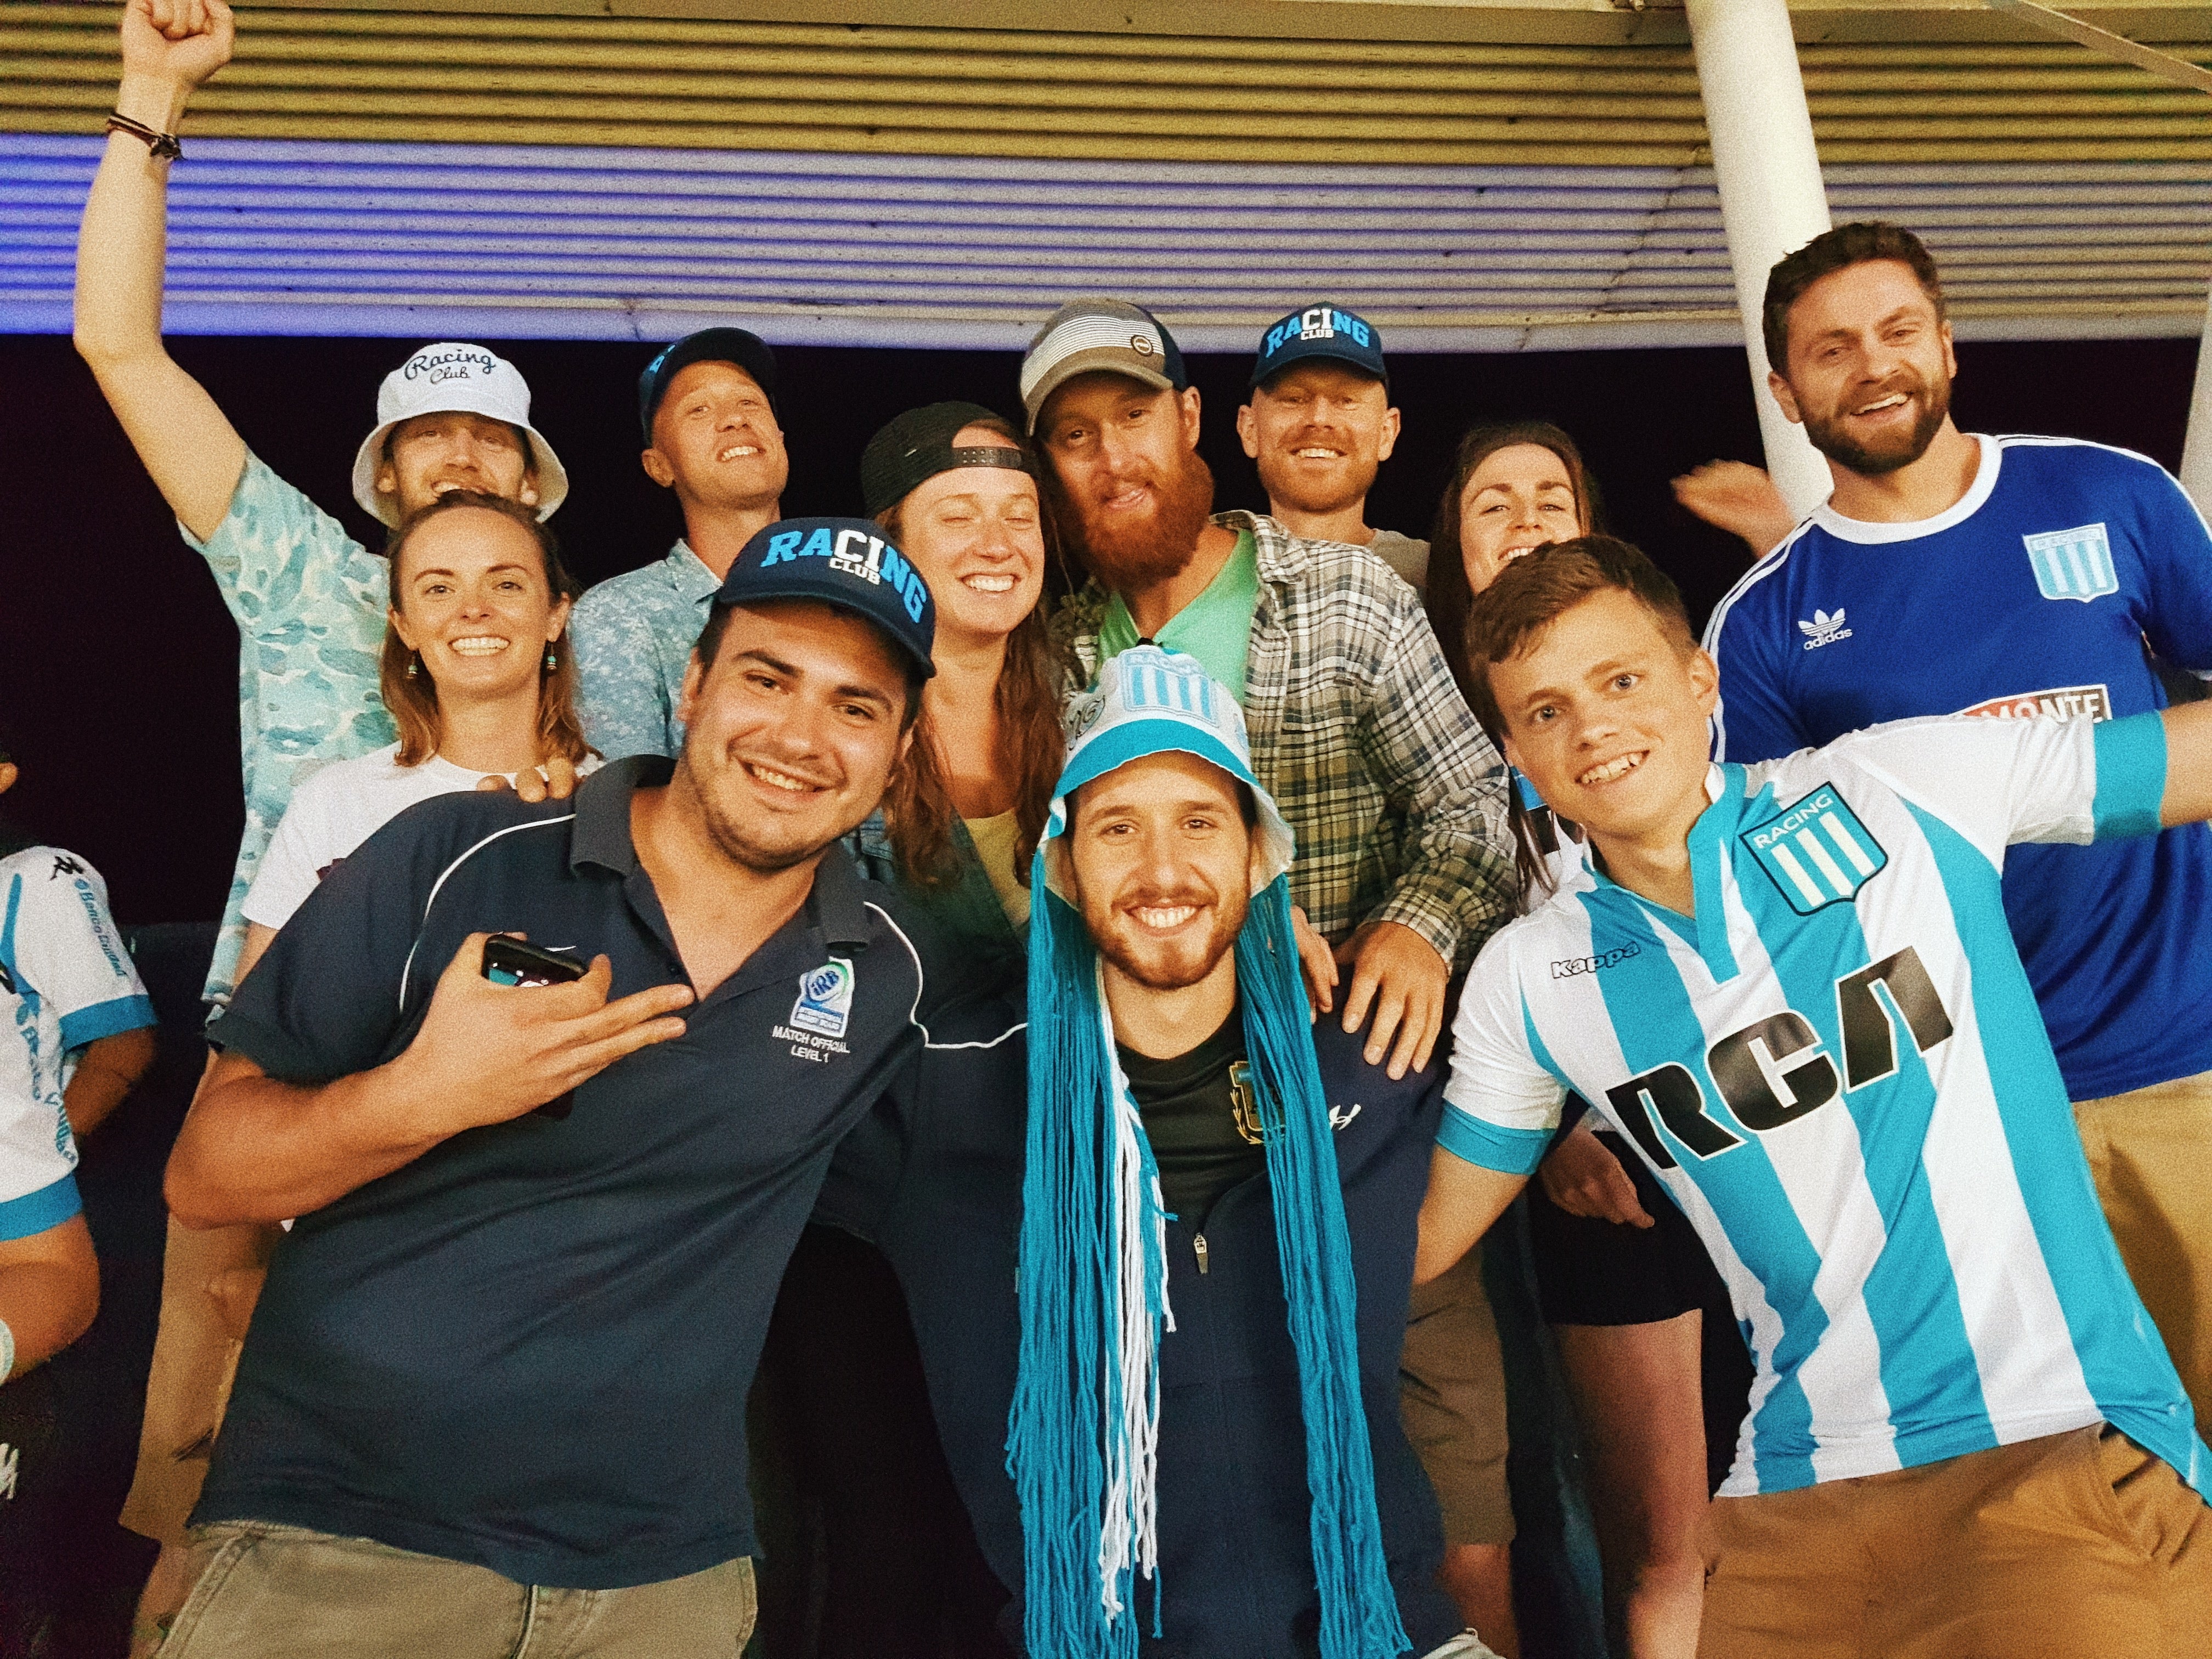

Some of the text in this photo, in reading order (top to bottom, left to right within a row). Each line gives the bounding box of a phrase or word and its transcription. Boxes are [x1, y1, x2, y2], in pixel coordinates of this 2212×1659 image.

[1266, 308, 1369, 358] RACING
[1301, 329, 1334, 341] CLUB
[404, 348, 496, 380] Racing
[430, 366, 470, 384] Club
[760, 528, 927, 624] RACING
[829, 557, 881, 585] CLUB
[1803, 628, 1853, 651] adidas
[1753, 793, 1833, 849] RACING
[1550, 940, 1641, 979] Kappa
[771, 1025, 850, 1054] MATCH OFFICIAL
[791, 1044, 829, 1063] LEVEL 1
[1605, 945, 1954, 1170] RCA
